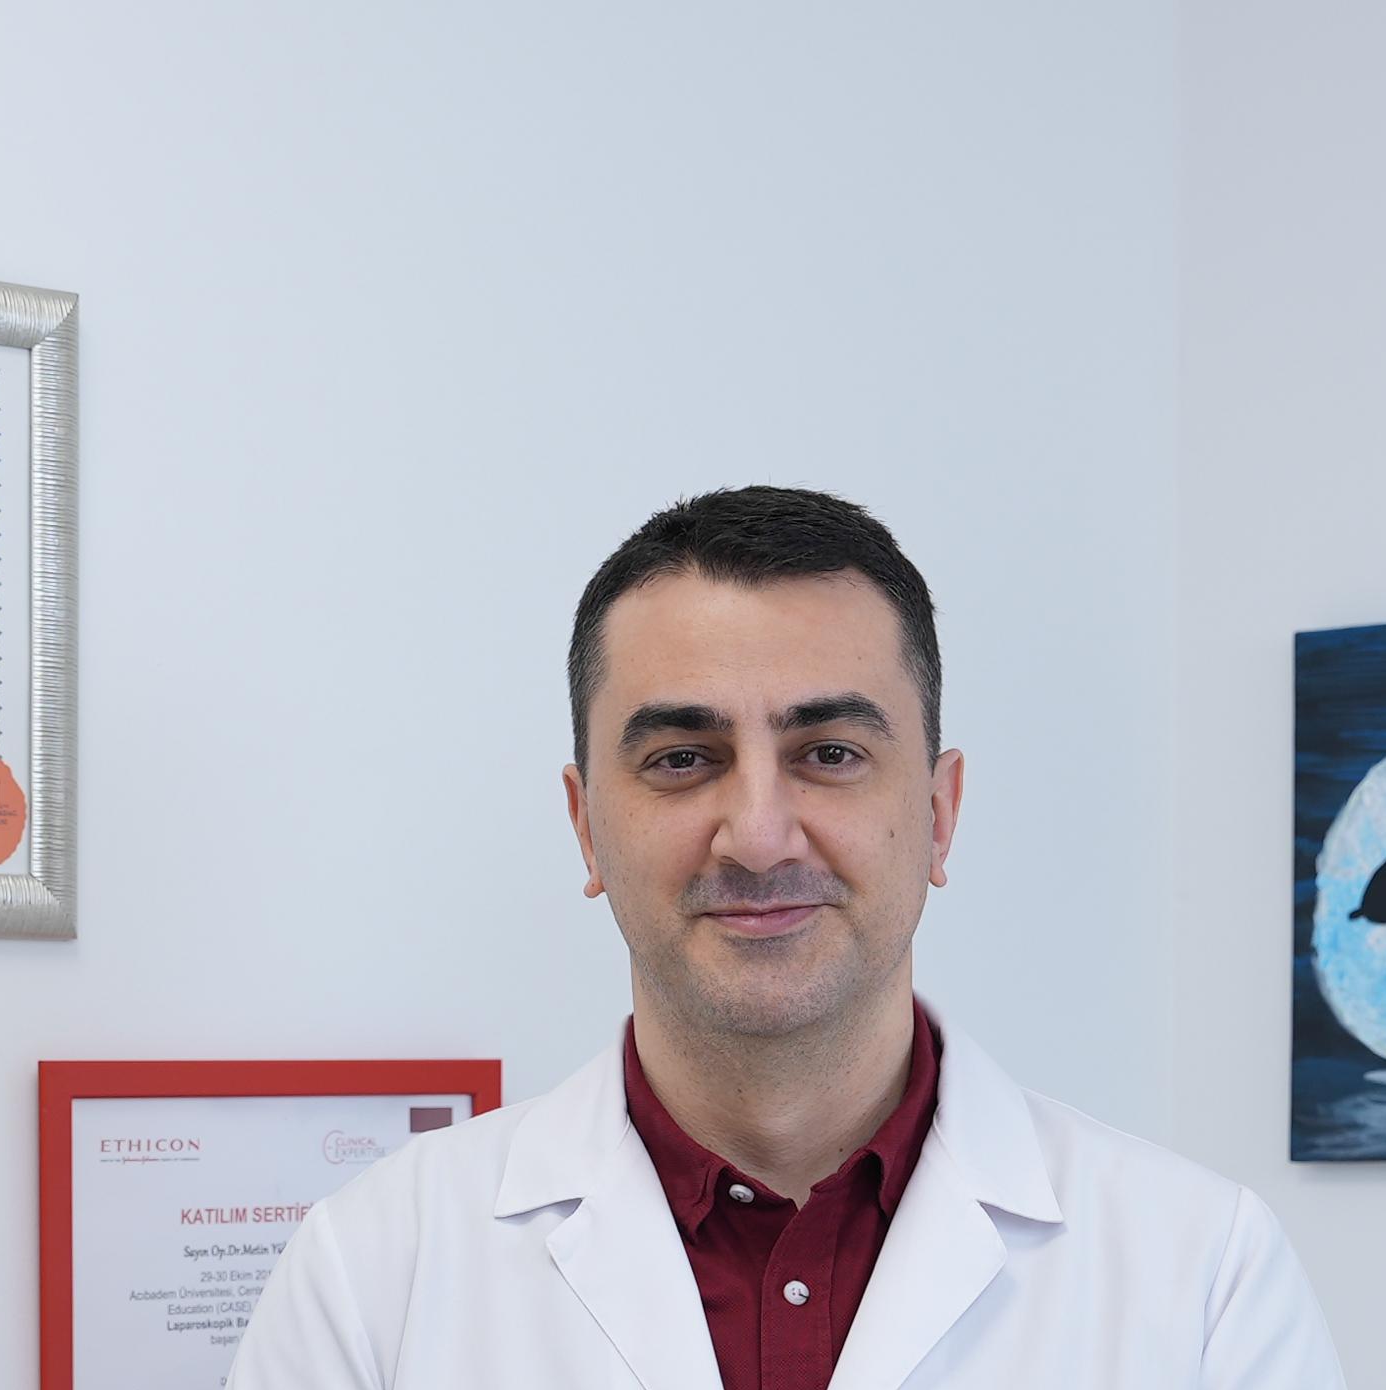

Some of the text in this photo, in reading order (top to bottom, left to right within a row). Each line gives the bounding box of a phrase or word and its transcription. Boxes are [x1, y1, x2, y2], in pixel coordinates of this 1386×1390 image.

[101, 1138, 201, 1153] ETHICON
[181, 1202, 313, 1225] KATILIM SERTİF
[183, 1246, 209, 1261] Sayın
[200, 1270, 253, 1282] 29-30 Ekim
[129, 1290, 177, 1301] Acıbadem
[167, 1304, 214, 1315] Education
